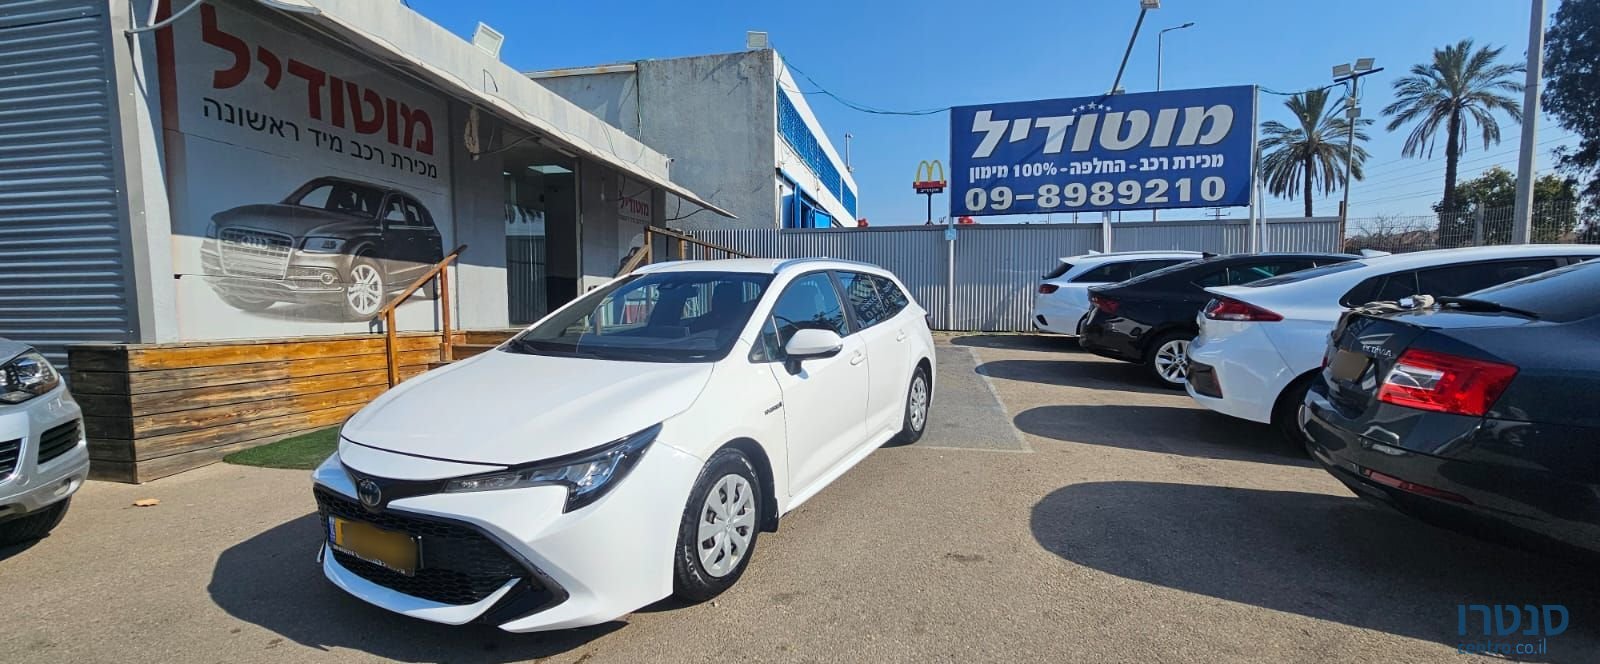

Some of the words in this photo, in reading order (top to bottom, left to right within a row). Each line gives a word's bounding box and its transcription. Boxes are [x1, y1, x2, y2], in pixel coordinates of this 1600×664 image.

[200, 3, 433, 155] מוטודיל
[203, 97, 300, 141] ראשונה
[971, 104, 1234, 158] מוטודיל
[308, 127, 343, 153] מיד
[351, 140, 385, 164] רכב
[391, 151, 438, 179] מכירת
[969, 165, 1008, 184] מימון
[1172, 154, 1224, 169] מכירת
[965, 176, 1226, 212] 09-8989210
